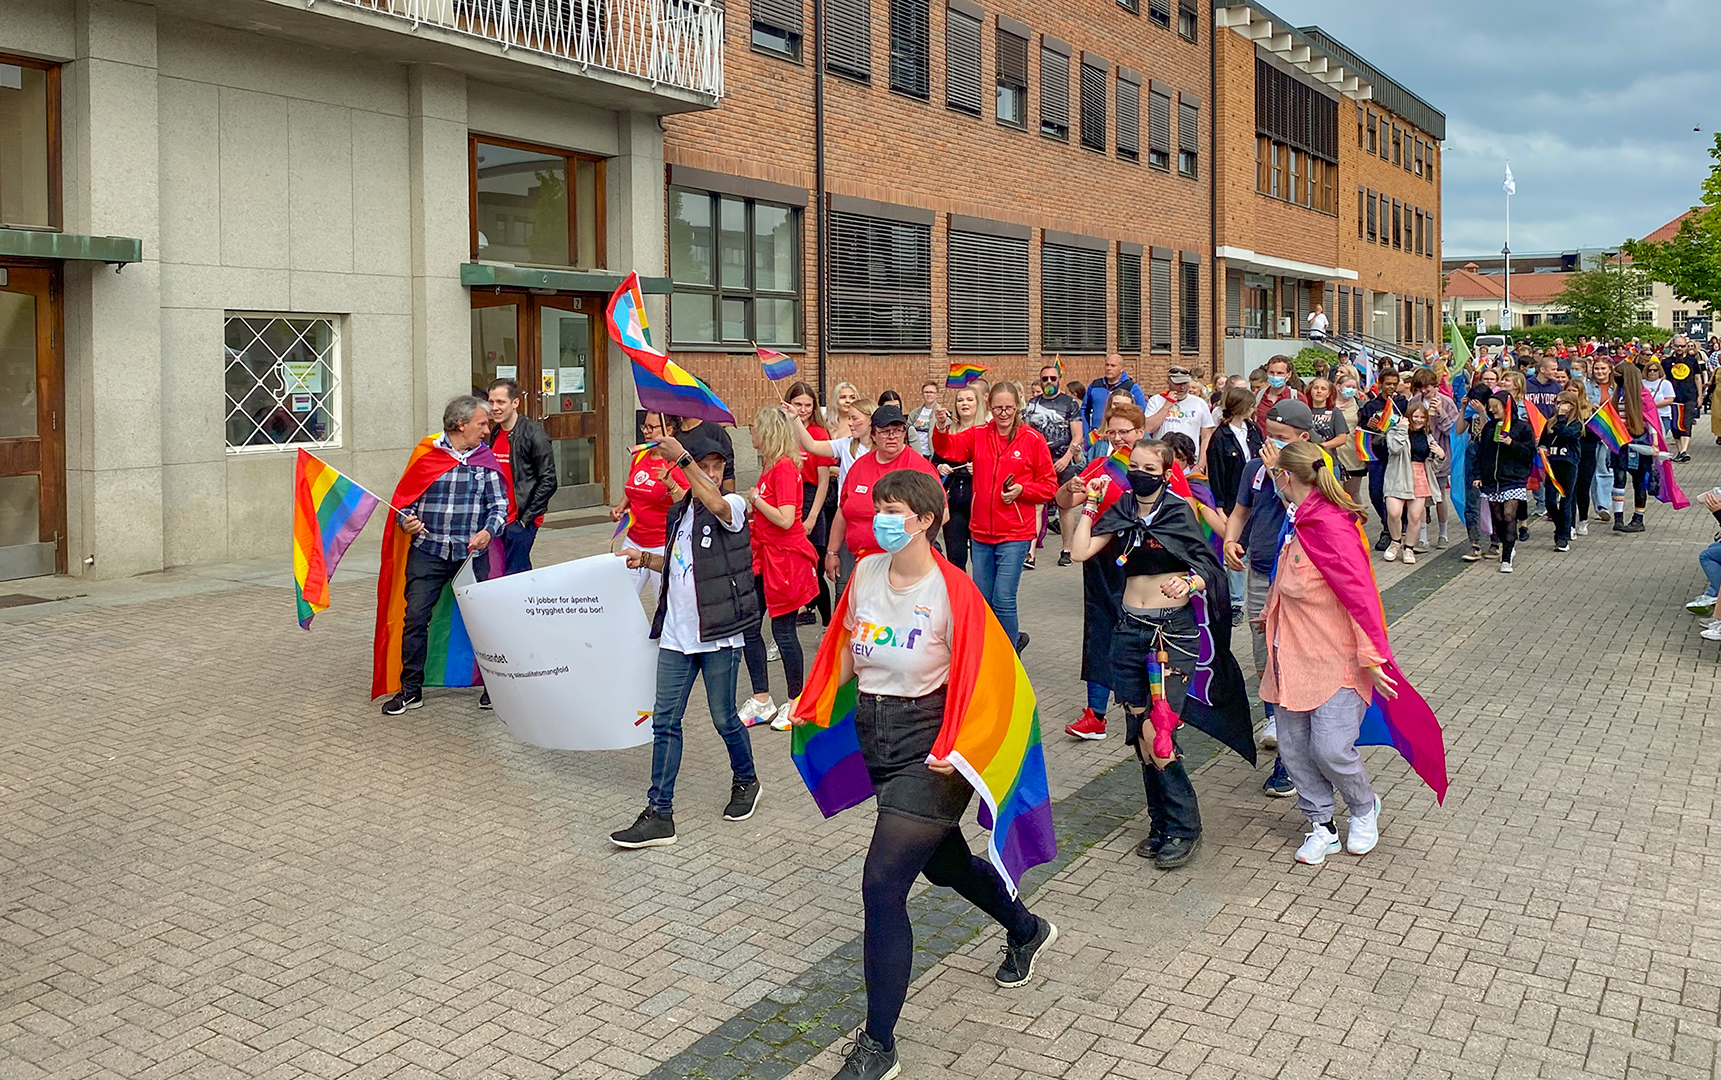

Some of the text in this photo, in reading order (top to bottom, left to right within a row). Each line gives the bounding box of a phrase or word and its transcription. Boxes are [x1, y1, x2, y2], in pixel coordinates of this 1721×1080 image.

[1502, 309, 1509, 317] P
[1478, 318, 1484, 326] P
[528, 596, 536, 604] Vi
[536, 596, 558, 605] jobber
[559, 595, 569, 604] for
[571, 596, 599, 605] åpenhet
[525, 606, 604, 616] og trygghet der du bor!
